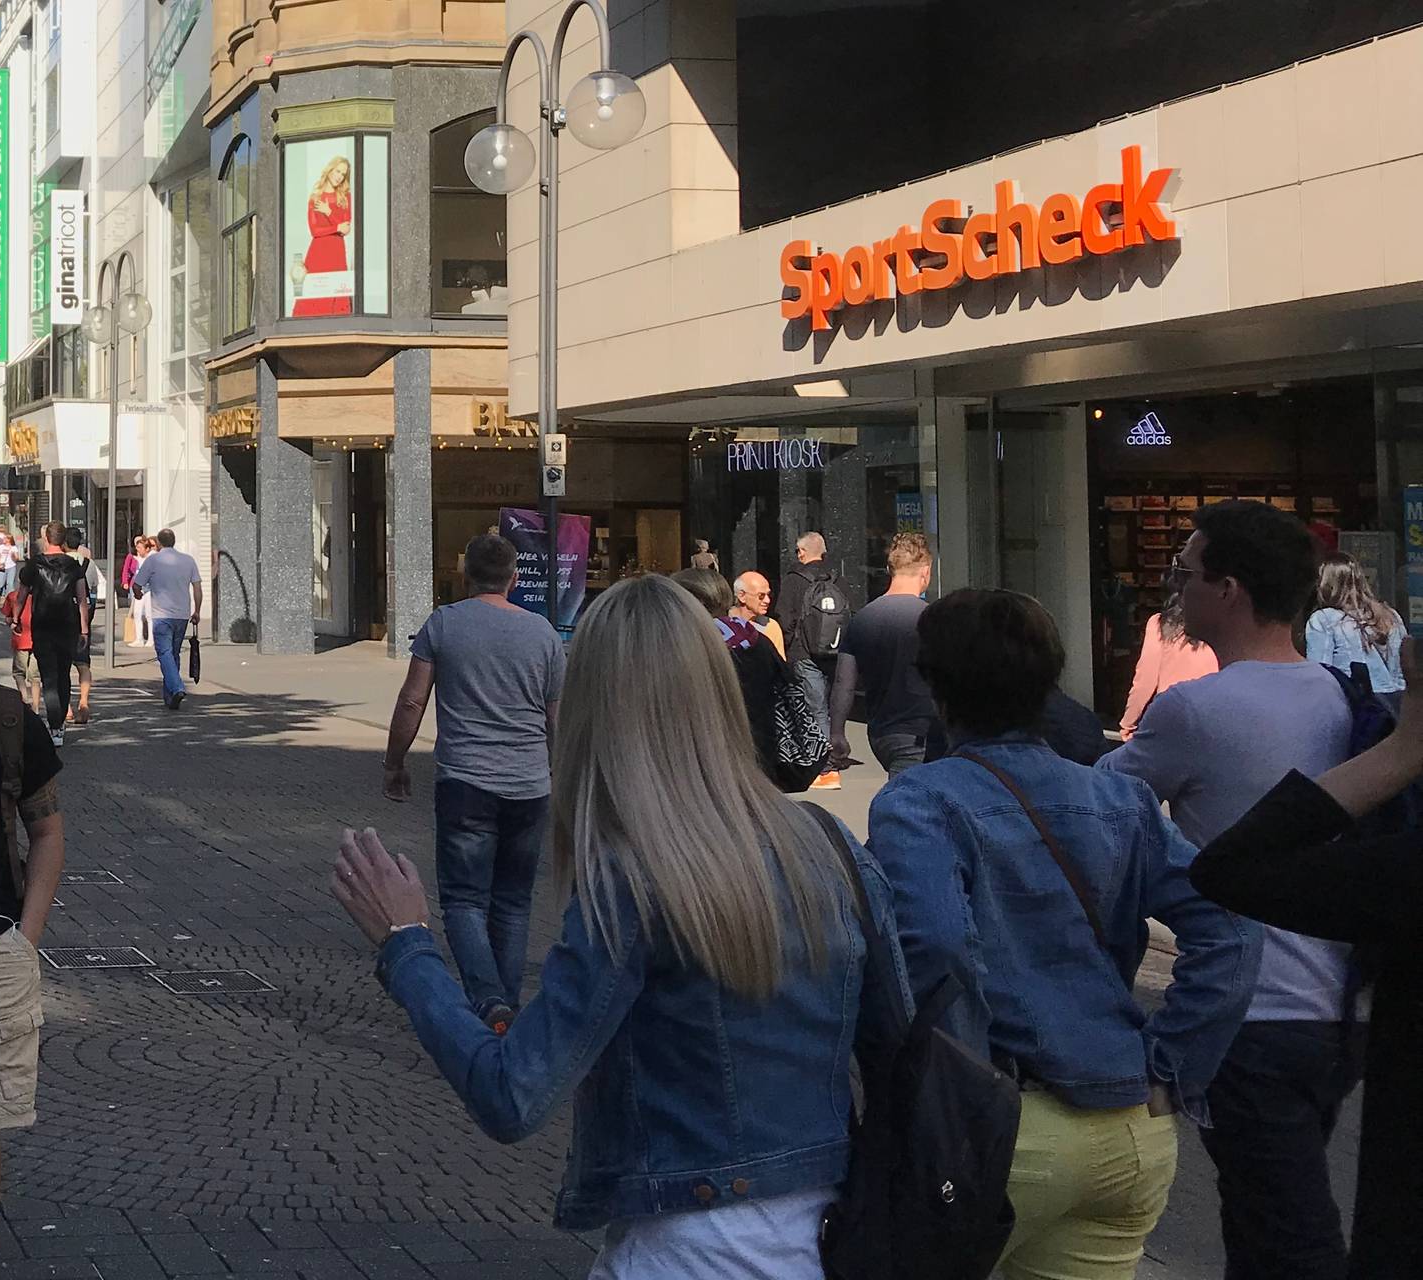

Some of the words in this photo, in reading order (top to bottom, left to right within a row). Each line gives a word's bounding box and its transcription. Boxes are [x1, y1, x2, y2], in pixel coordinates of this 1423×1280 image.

[780, 144, 1178, 331] SportScheck
[1127, 433, 1172, 445] adidas
[727, 441, 768, 472] PRINT
[773, 437, 824, 469] KIOSK
[523, 594, 546, 603] SEIN.
